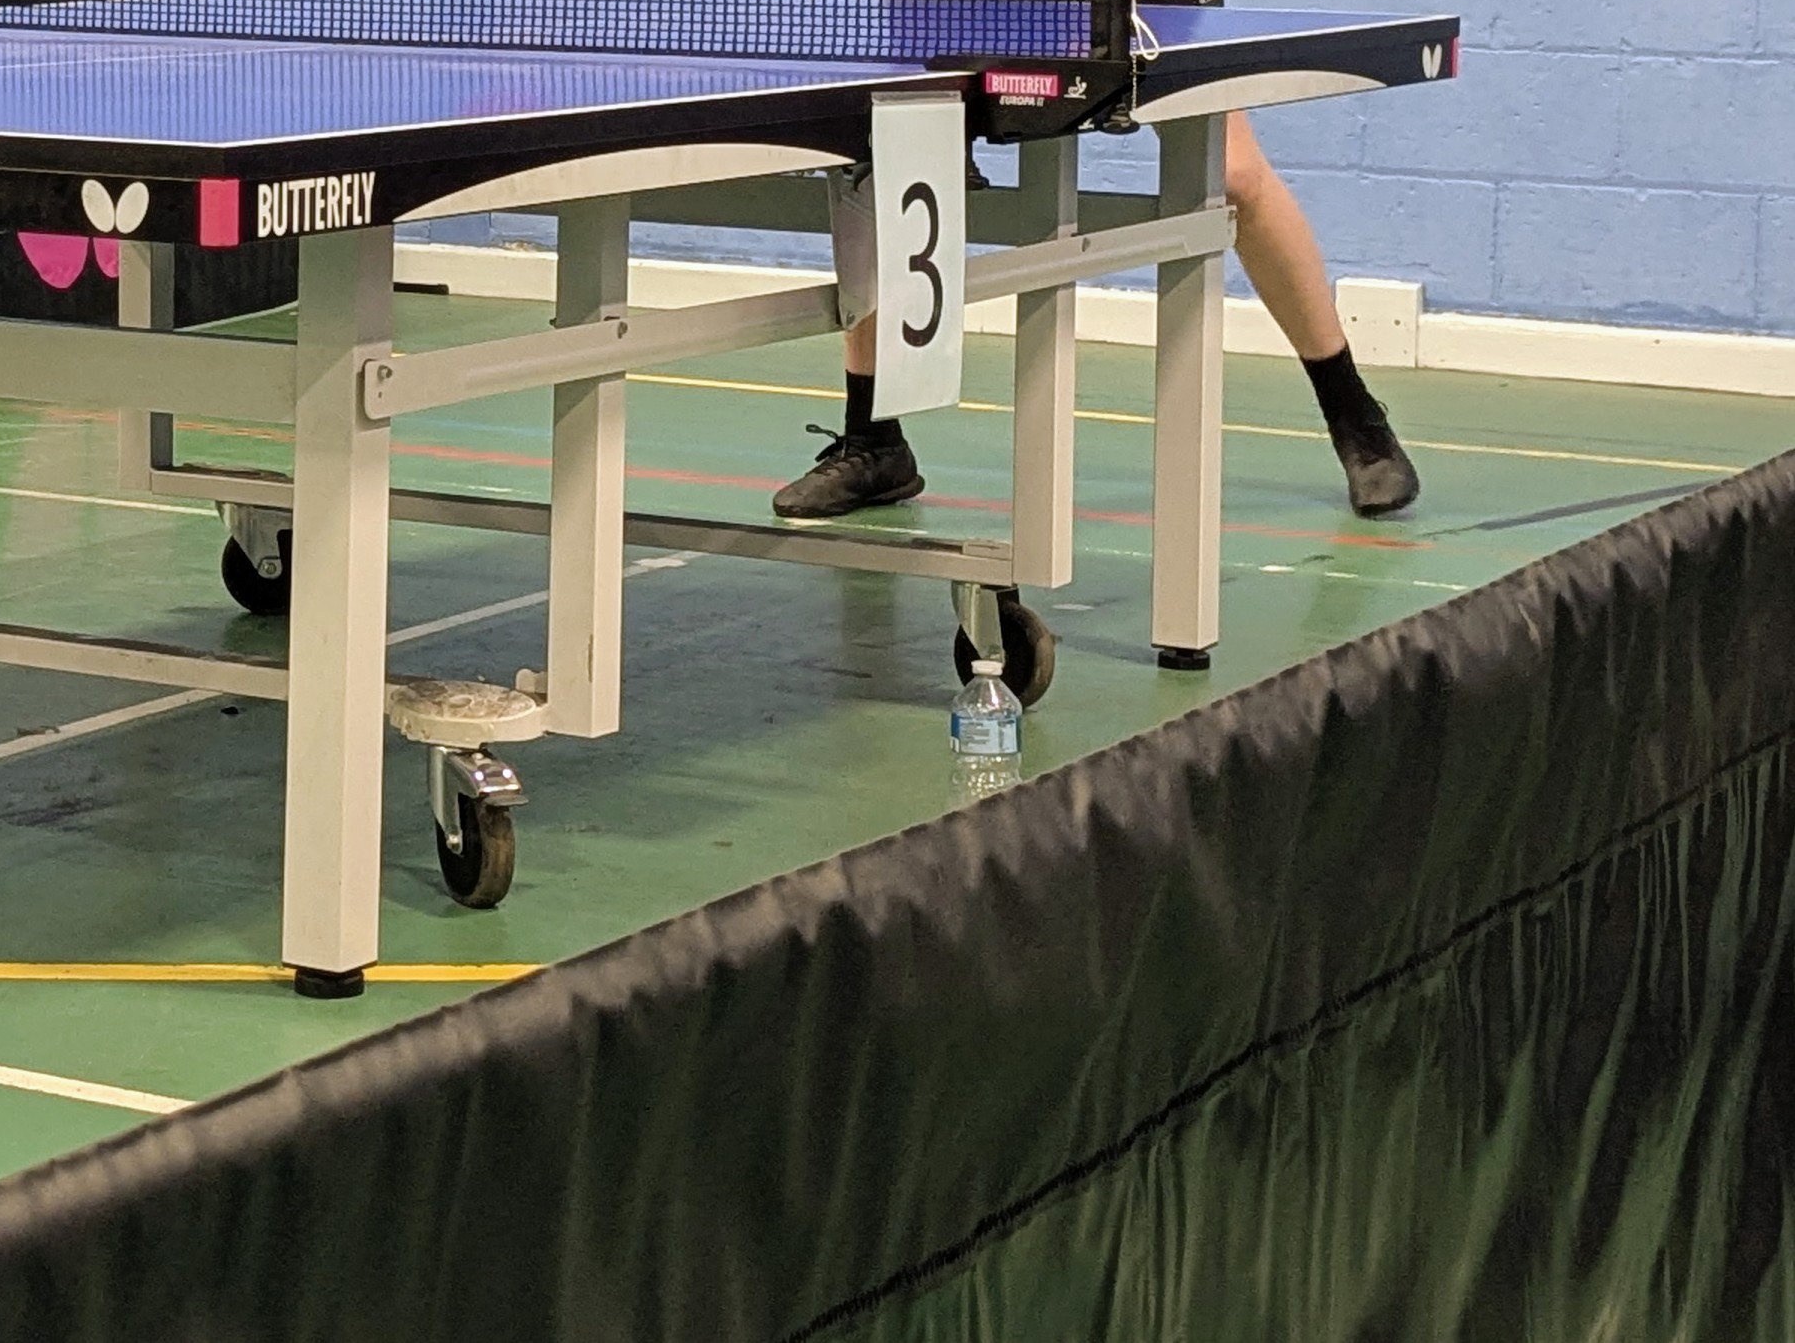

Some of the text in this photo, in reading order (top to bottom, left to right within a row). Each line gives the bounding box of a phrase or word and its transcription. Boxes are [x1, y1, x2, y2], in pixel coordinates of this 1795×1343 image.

[991, 74, 1054, 95] BUTTERFLY
[999, 95, 1035, 106] EUROPA
[257, 171, 377, 238] BUTTERFLY
[901, 181, 943, 348] 3
